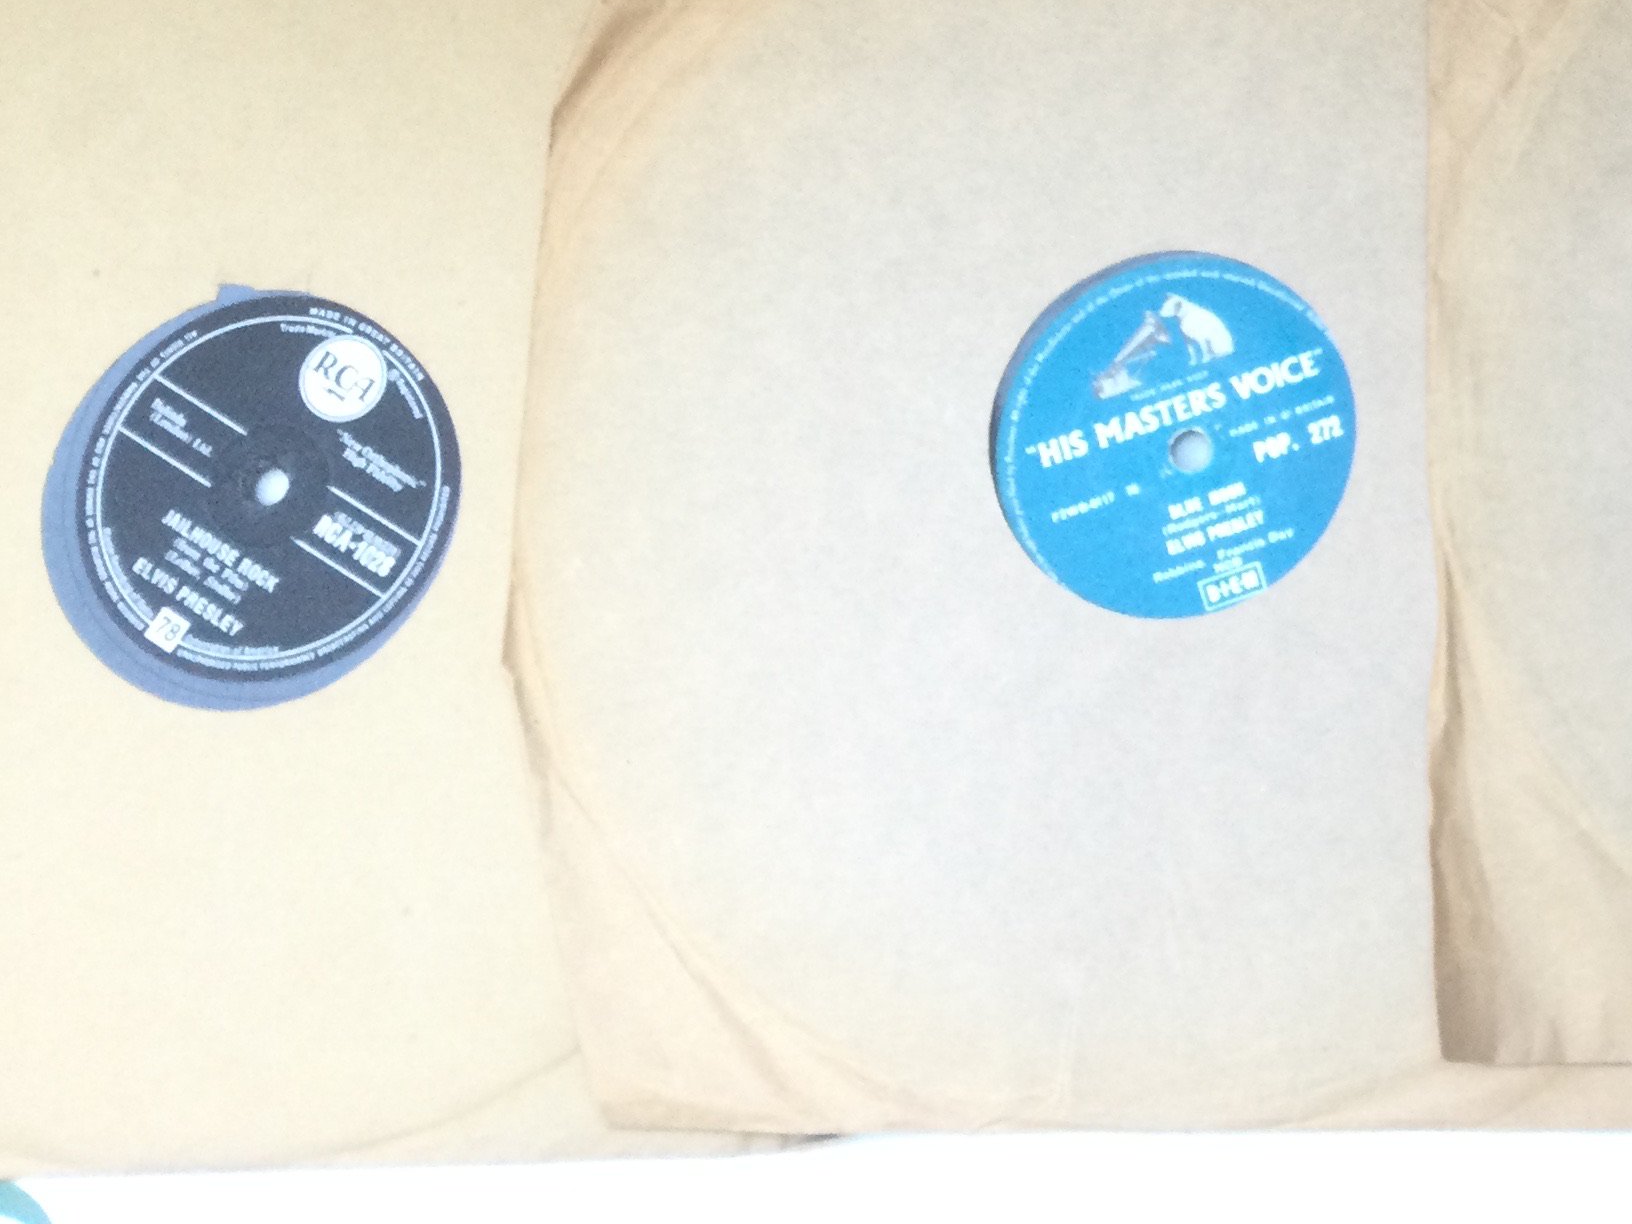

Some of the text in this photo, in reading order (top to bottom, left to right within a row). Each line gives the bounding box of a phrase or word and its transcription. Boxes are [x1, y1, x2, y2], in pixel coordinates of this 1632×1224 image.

[313, 349, 376, 404] RCA
[160, 509, 280, 594] JAILHOUSE ROCK
[312, 513, 396, 578] RCA-1028
[132, 557, 179, 594] ELVIS
[175, 585, 244, 637] PRESLEY
[155, 615, 181, 642] 78
